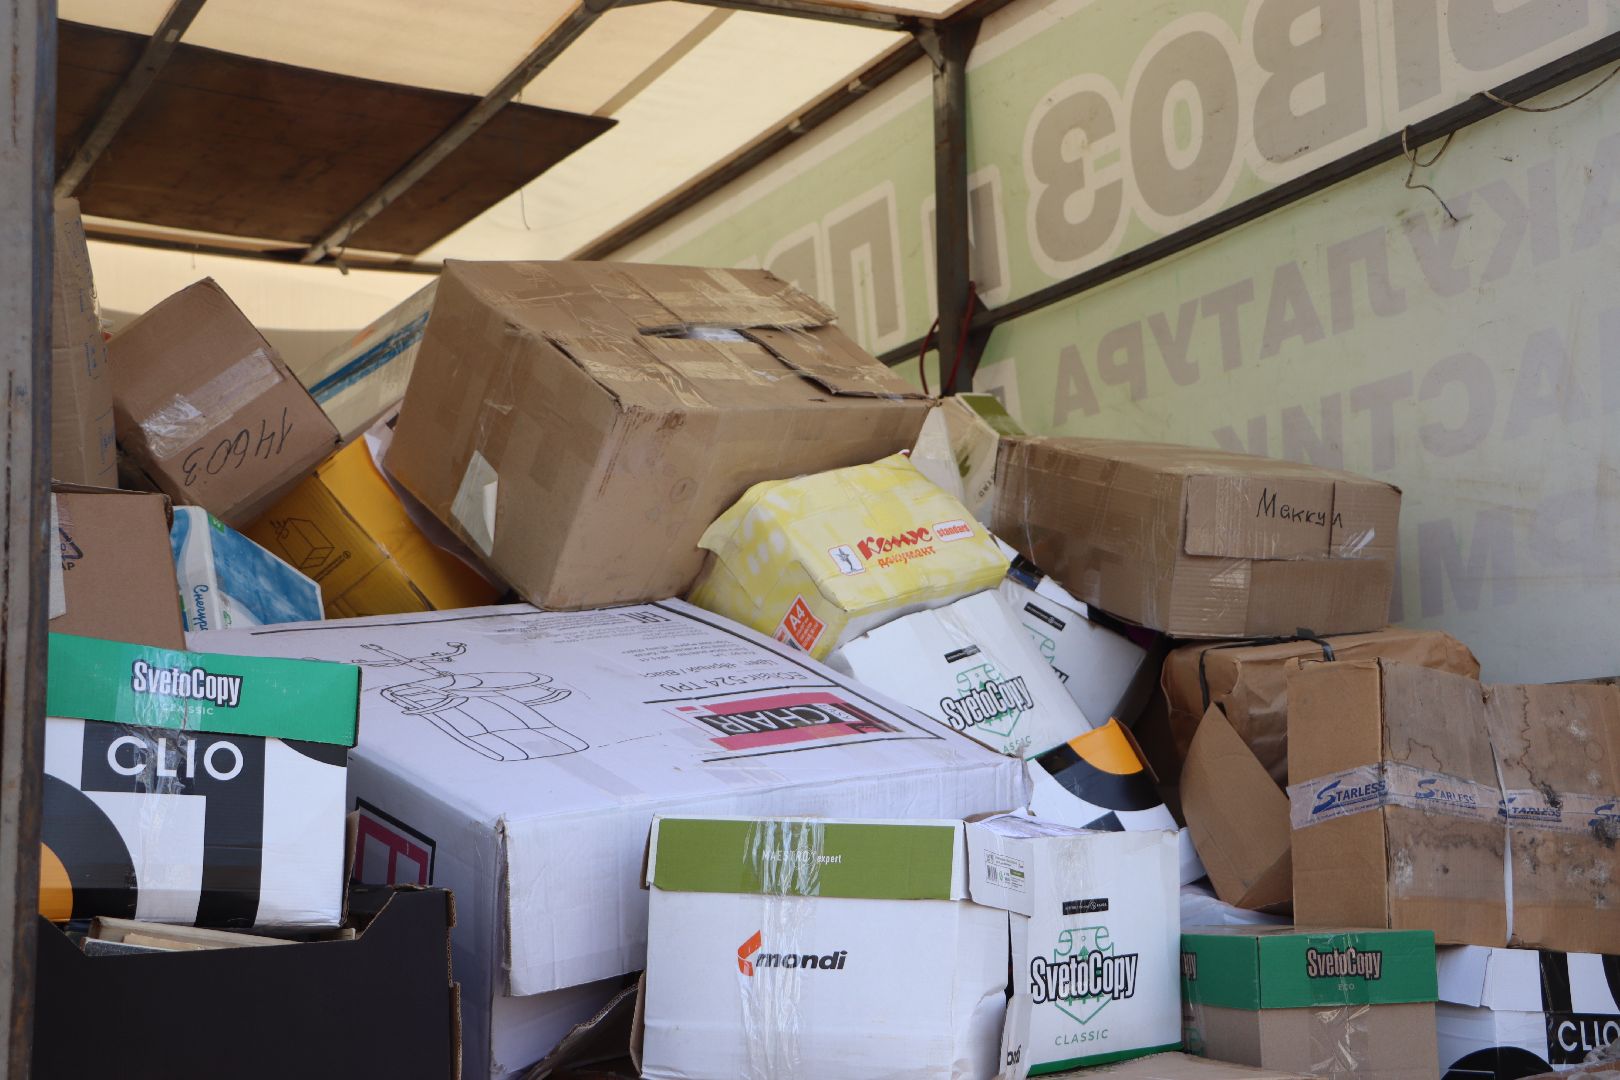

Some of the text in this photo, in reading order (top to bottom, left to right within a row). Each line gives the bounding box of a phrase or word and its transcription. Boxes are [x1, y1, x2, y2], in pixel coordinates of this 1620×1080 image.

[182, 406, 293, 487] 14603
[131, 659, 244, 709] SvetoCopy
[940, 675, 1034, 732] SvetoCopy
[703, 706, 831, 734] CHAIR
[107, 735, 244, 781] CLIO
[816, 854, 842, 866] expert
[756, 949, 848, 970] mondi
[1306, 947, 1383, 979] SvetoCopy
[1030, 950, 1139, 1004] SvetoCopy
[1338, 983, 1355, 991] ECO
[1055, 1029, 1109, 1046] CLASSIC
